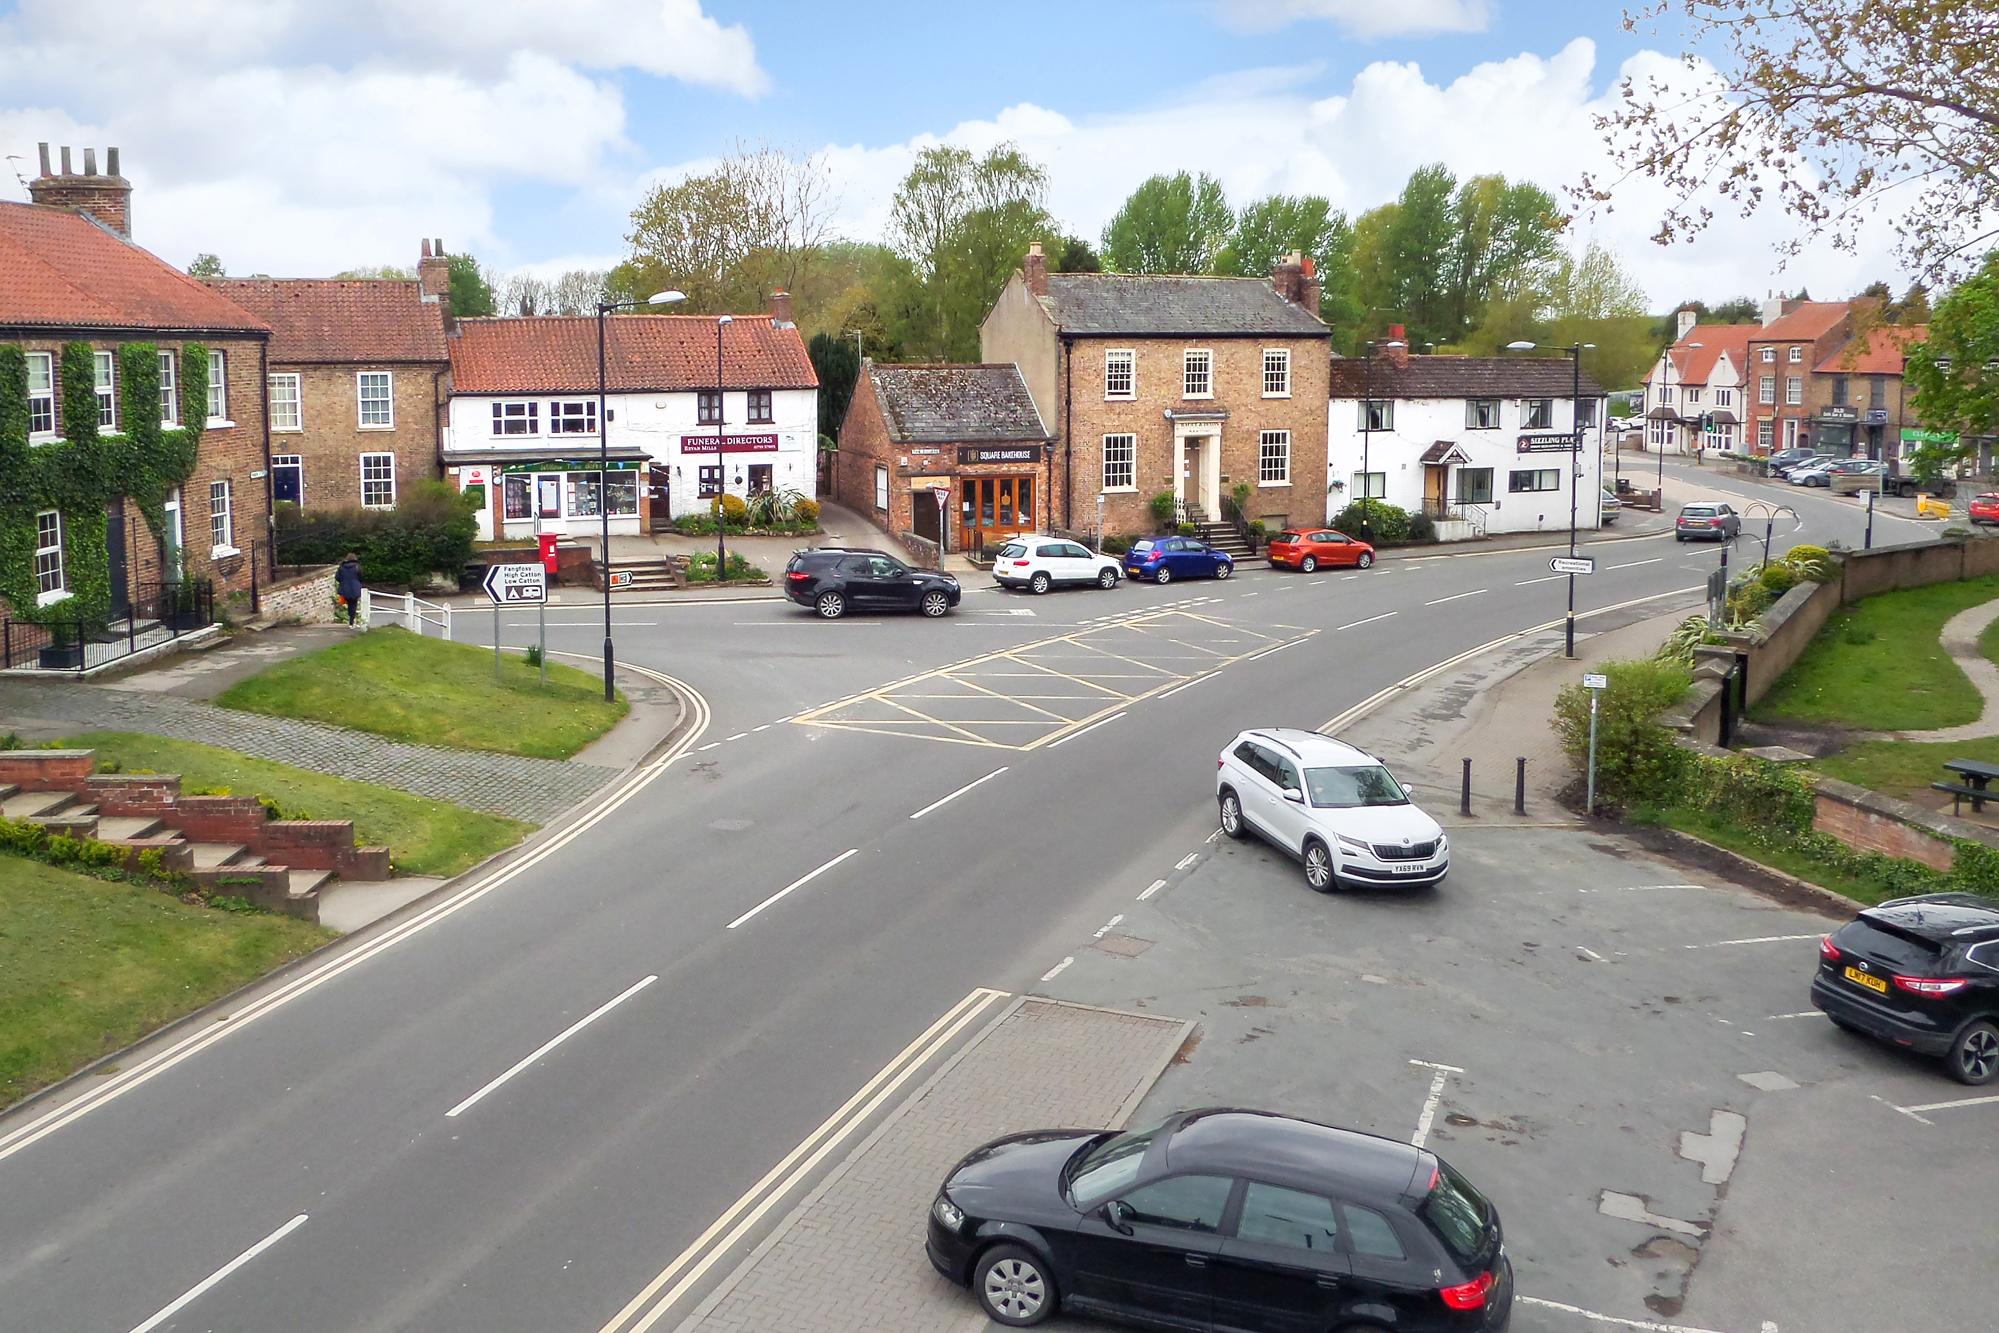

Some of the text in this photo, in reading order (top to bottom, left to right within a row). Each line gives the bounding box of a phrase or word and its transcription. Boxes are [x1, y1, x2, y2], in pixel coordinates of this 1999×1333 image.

[727, 436, 773, 445] DIRECTORS
[1530, 437, 1559, 445] SIZZLING
[979, 450, 1031, 460] SQUARE BAKEHOUSE
